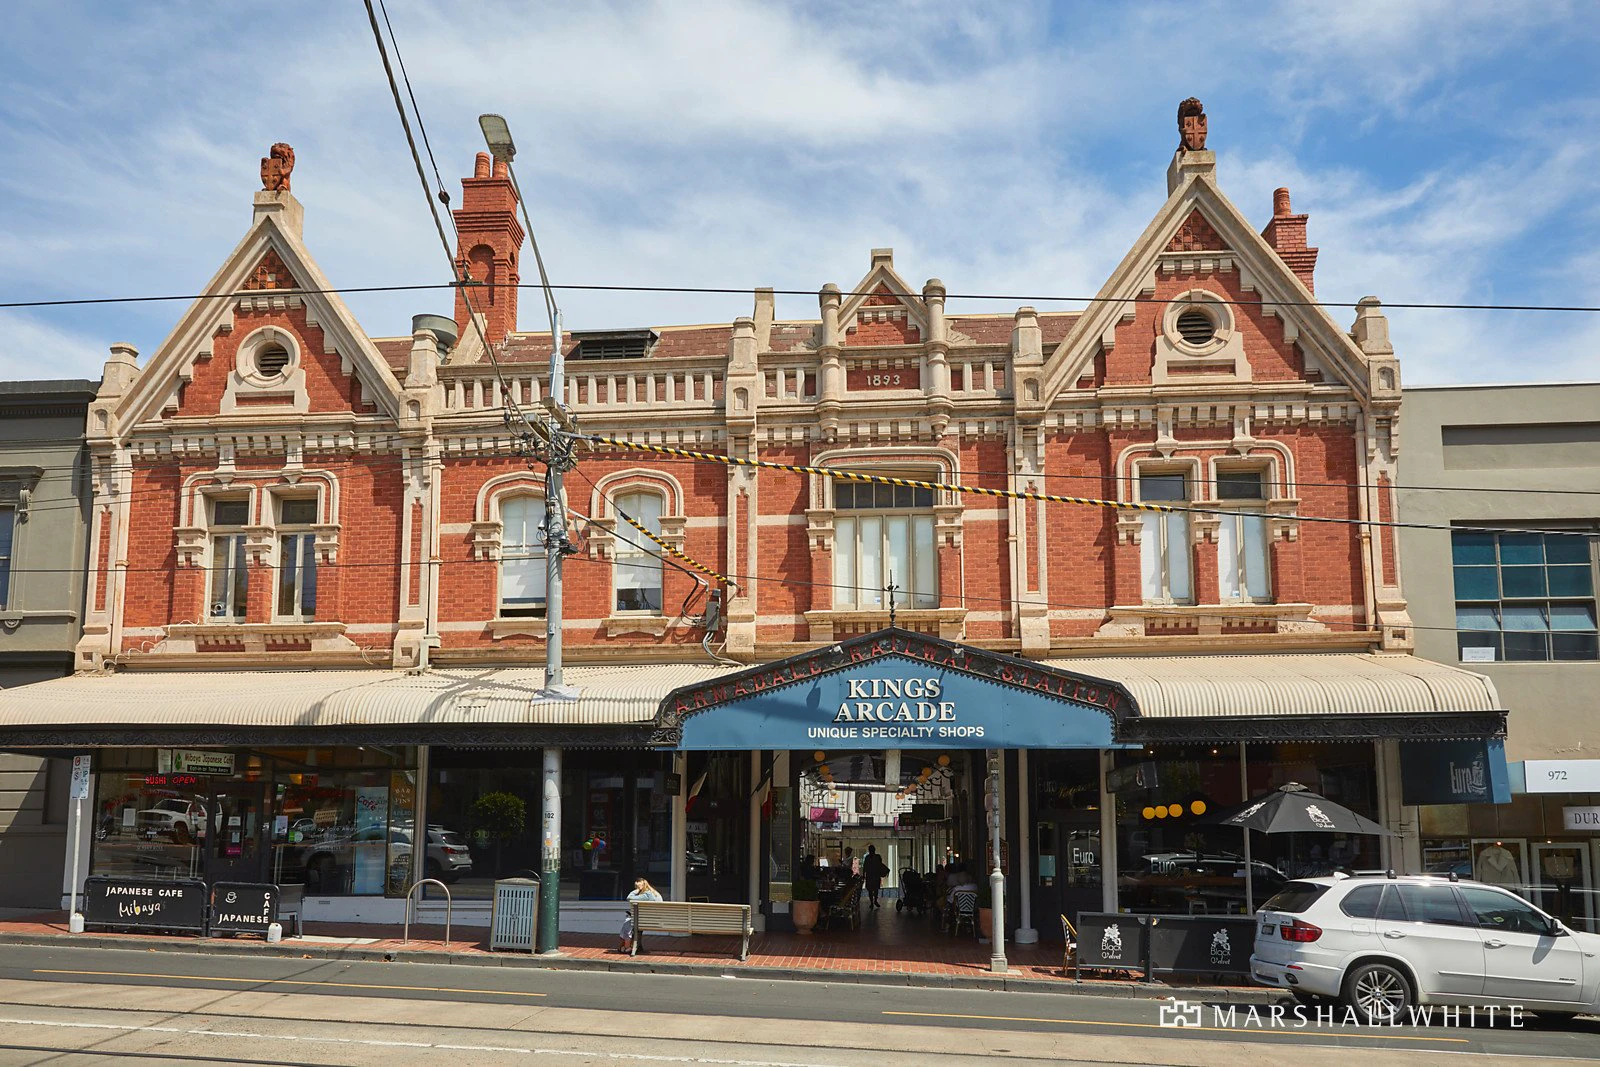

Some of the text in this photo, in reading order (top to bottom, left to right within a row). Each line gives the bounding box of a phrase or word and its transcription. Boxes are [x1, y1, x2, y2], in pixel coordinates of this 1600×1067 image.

[866, 374, 901, 386] 1893
[676, 634, 1122, 715] ARMADALE RAILWAY STATION
[848, 678, 941, 699] KINGS
[833, 702, 957, 722] ARCADE
[808, 726, 985, 738] UNIQUE SPECIALTY SHOPS
[203, 754, 222, 765] Japanese
[145, 776, 196, 785] SUSHI OPEN
[1548, 771, 1568, 780] 972
[1073, 847, 1095, 864] Euro
[106, 886, 183, 897] JAPANESE CAFE
[118, 900, 161, 918] Mibaya
[217, 914, 269, 925] JAPANESE
